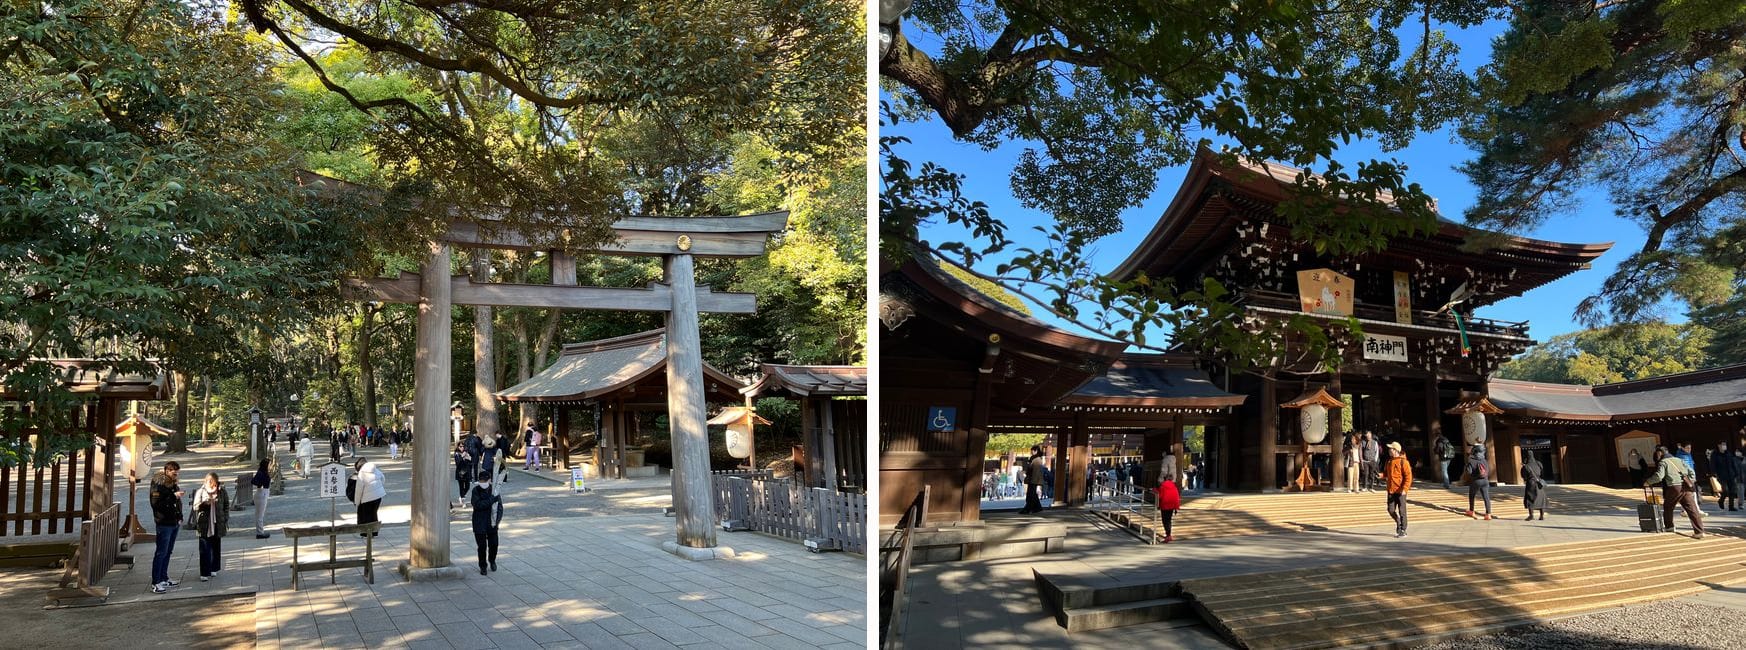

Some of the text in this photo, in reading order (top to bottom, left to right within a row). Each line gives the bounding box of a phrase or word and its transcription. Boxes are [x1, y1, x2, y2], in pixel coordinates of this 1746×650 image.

[1366, 336, 1405, 356] 南神門
[330, 467, 338, 494] 西参道
